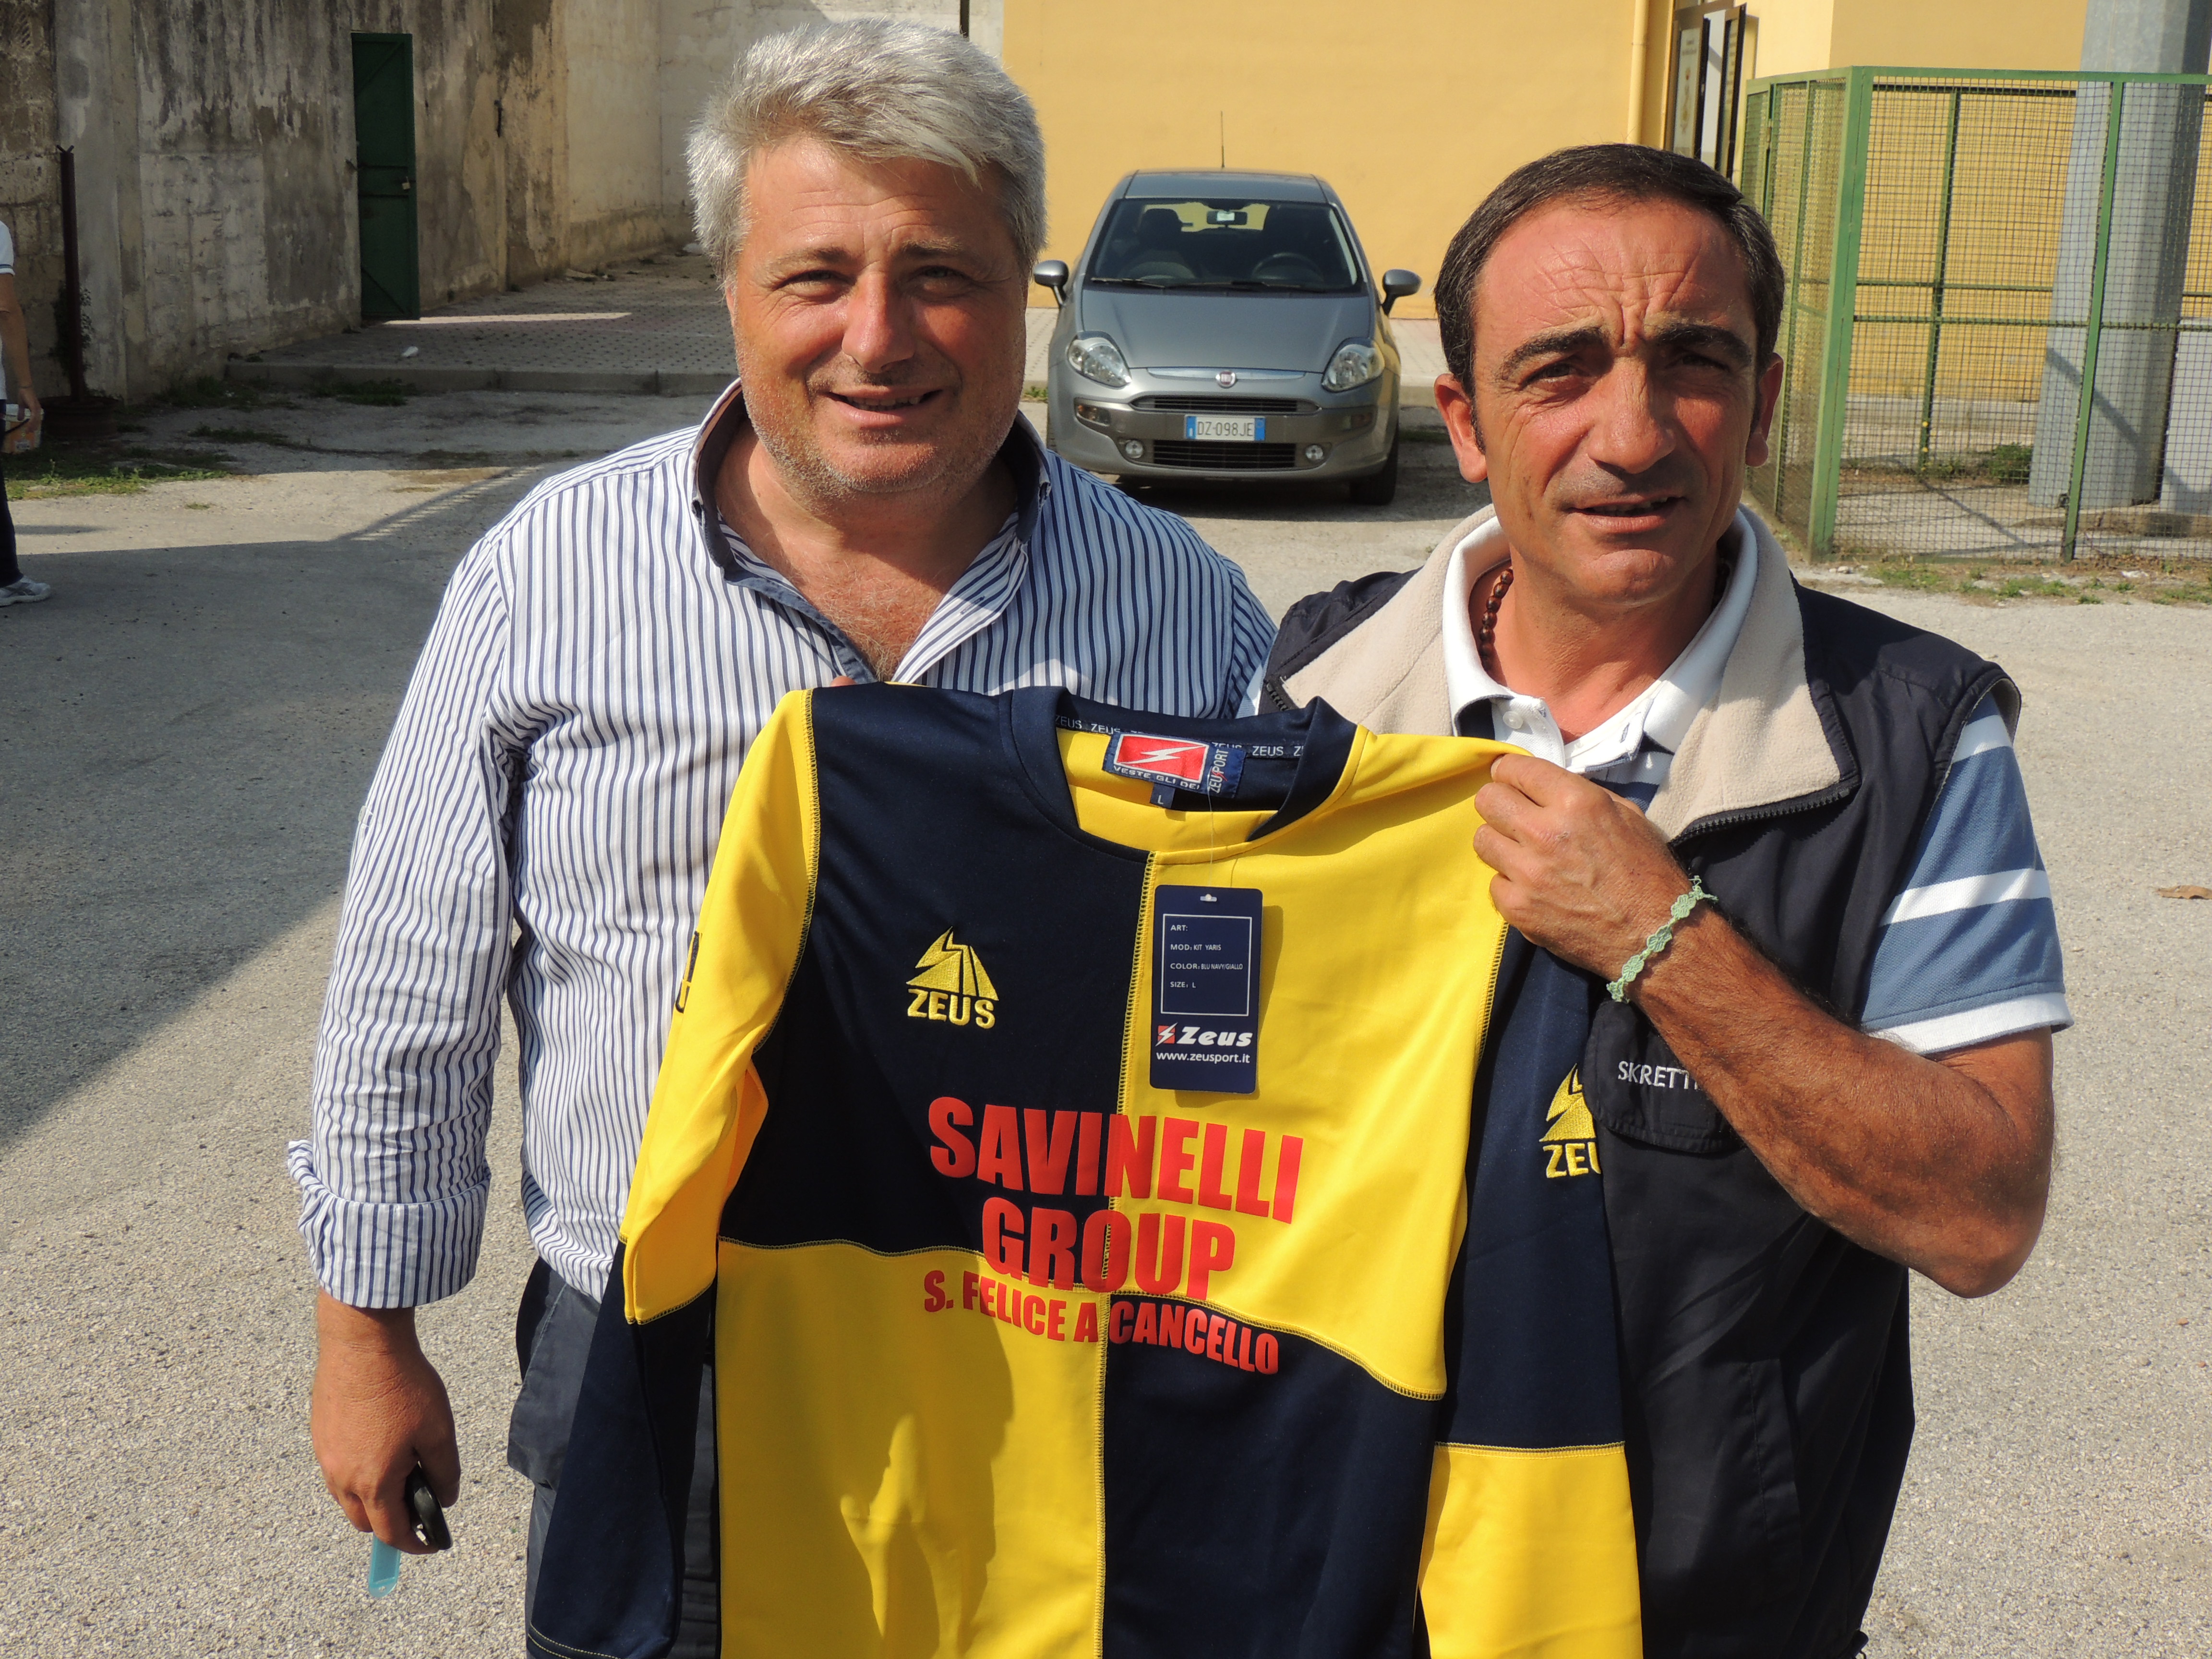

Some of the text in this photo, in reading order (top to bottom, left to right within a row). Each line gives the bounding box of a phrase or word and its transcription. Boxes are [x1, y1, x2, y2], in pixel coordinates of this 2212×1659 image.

[1056, 715, 1082, 729] ZEUS
[1252, 745, 1284, 756] ZEUS
[1114, 765, 1200, 790] VESTE GLI DEI
[1157, 795, 1164, 805] L
[907, 988, 995, 1029] ZEUS
[1177, 1026, 1253, 1047] Zeus
[1156, 1052, 1250, 1064] www.zeusport.it
[928, 1096, 1304, 1225] SAVINELLI
[1542, 1142, 1601, 1178] ZEU
[982, 1197, 1236, 1300] GROUP
[924, 1270, 1279, 1375] S. FELICE A CANCELLO
